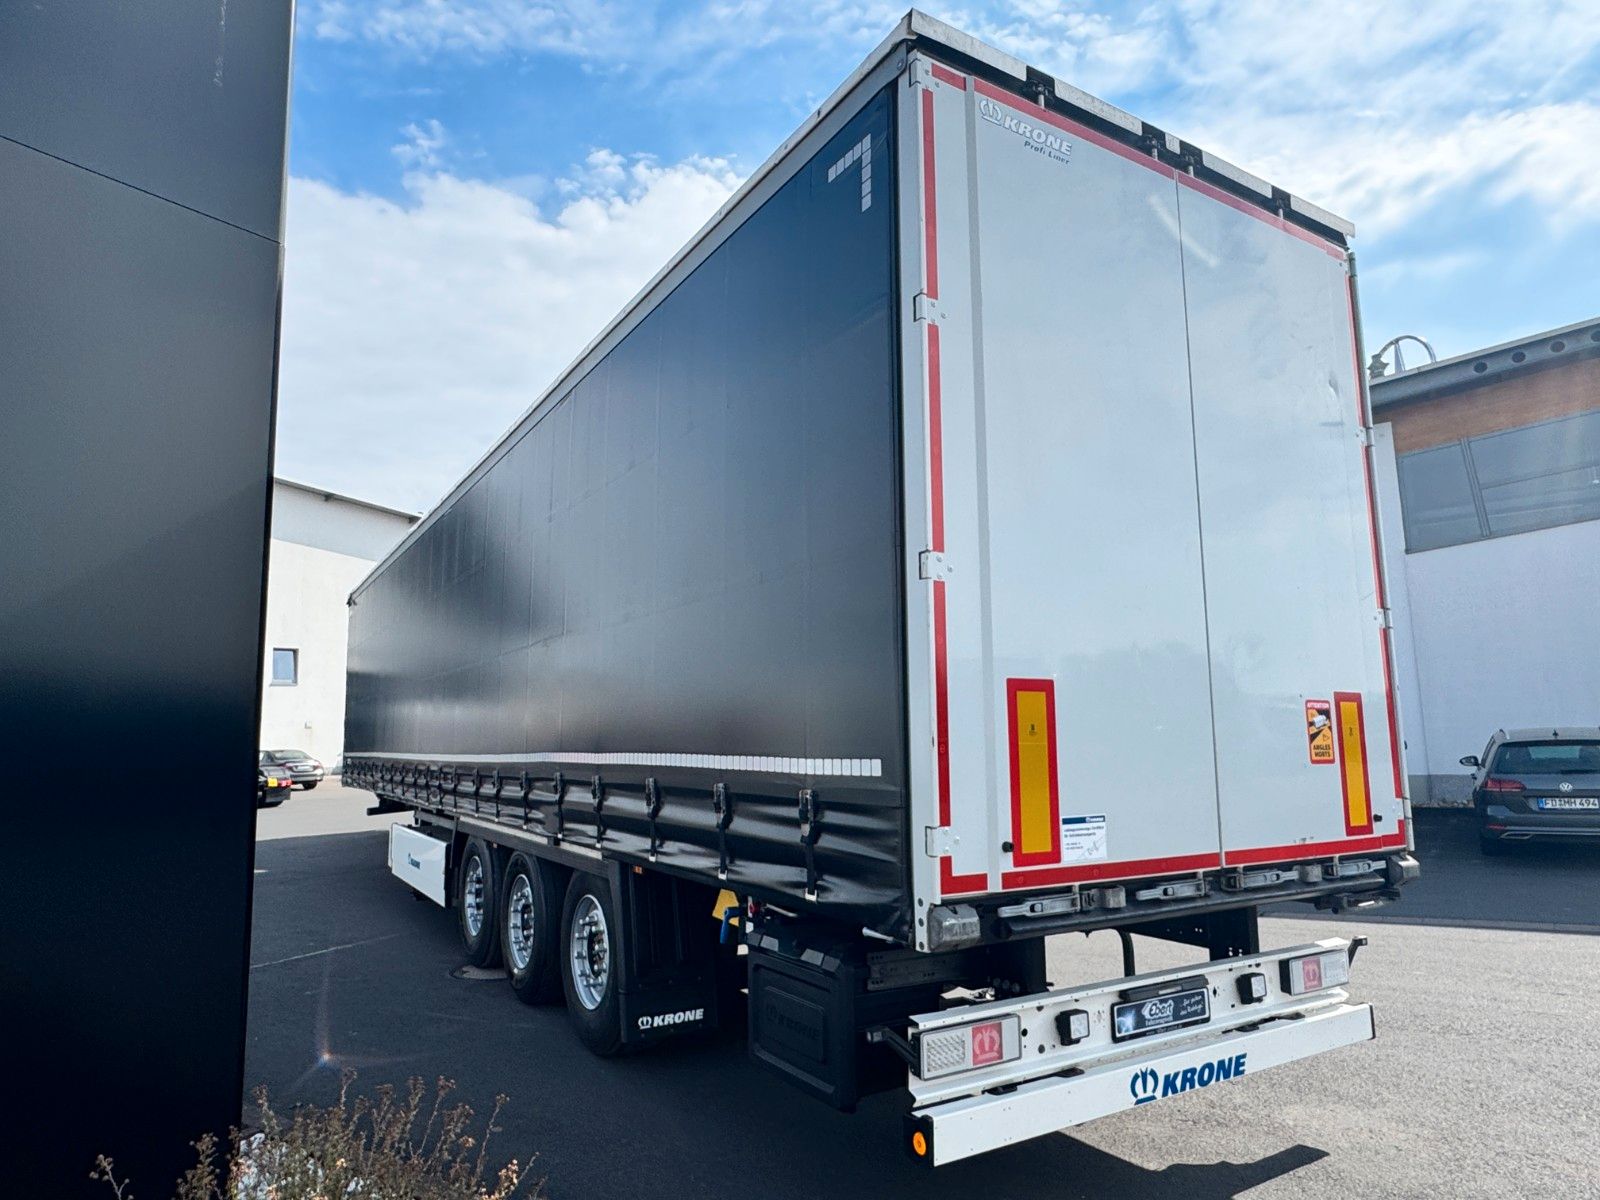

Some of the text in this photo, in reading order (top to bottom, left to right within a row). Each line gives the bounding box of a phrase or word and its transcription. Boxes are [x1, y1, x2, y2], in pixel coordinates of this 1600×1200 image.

[1003, 115, 1072, 156] KRONE
[1024, 140, 1045, 155] Profi
[653, 1008, 704, 1027] KRONE
[1161, 1052, 1247, 1098] KRONE
